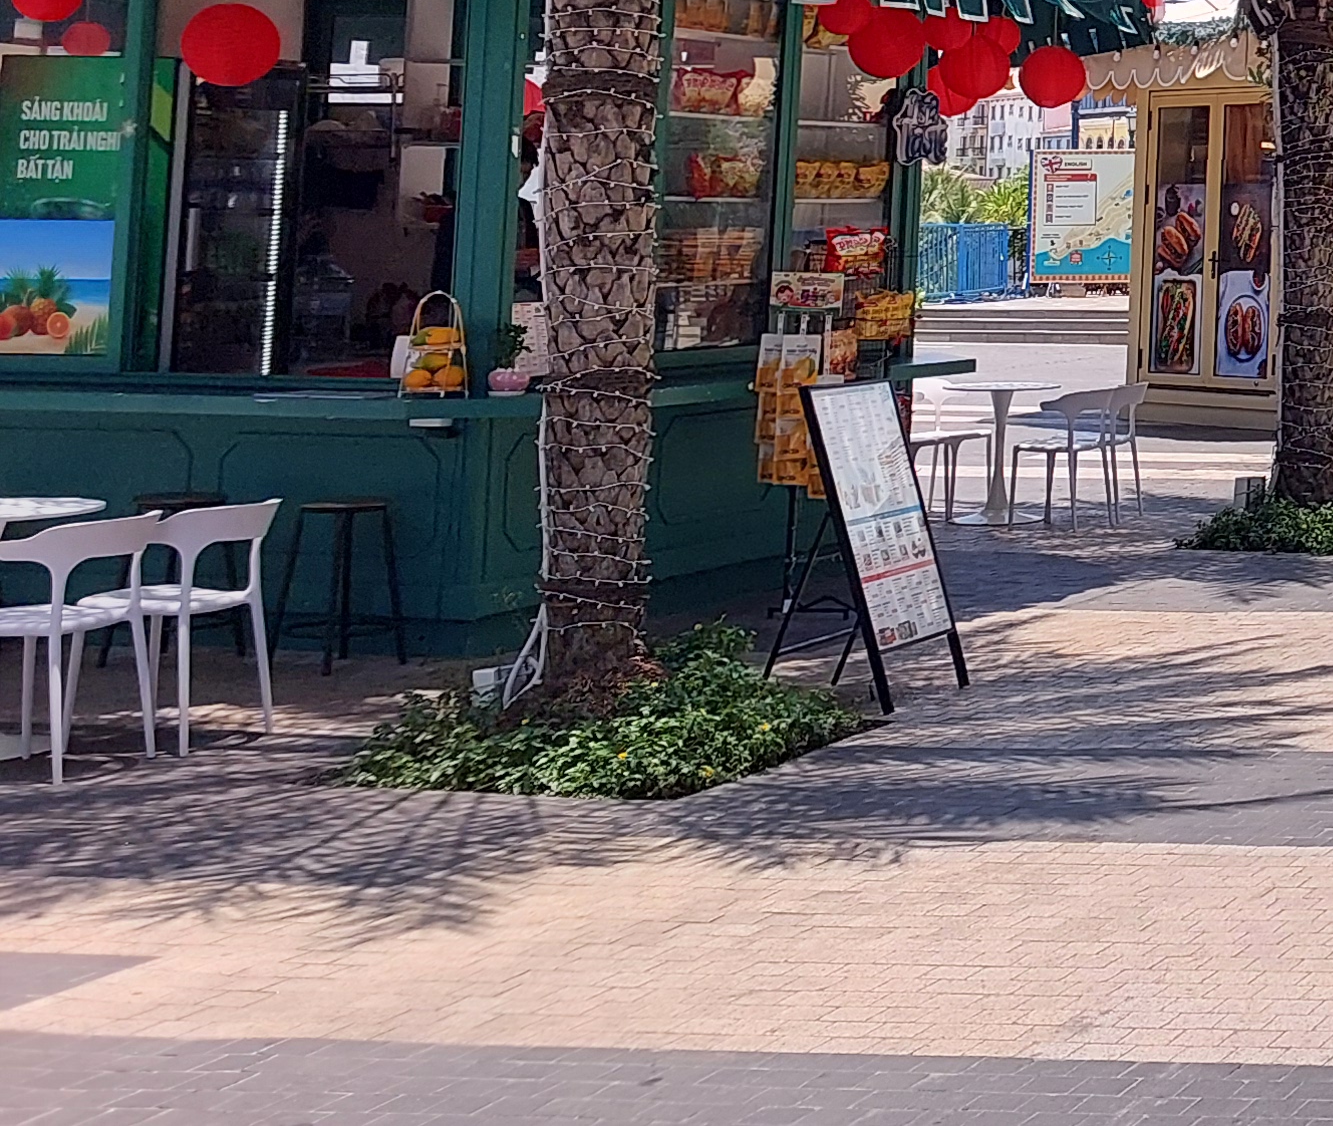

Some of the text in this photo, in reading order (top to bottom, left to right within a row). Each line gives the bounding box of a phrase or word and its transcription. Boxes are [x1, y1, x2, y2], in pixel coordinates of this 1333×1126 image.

[21, 96, 108, 121] SẢNG KHOÁI
[20, 126, 121, 151] CHO TRẢI NGHI
[17, 154, 74, 183] BẤT TẬN
